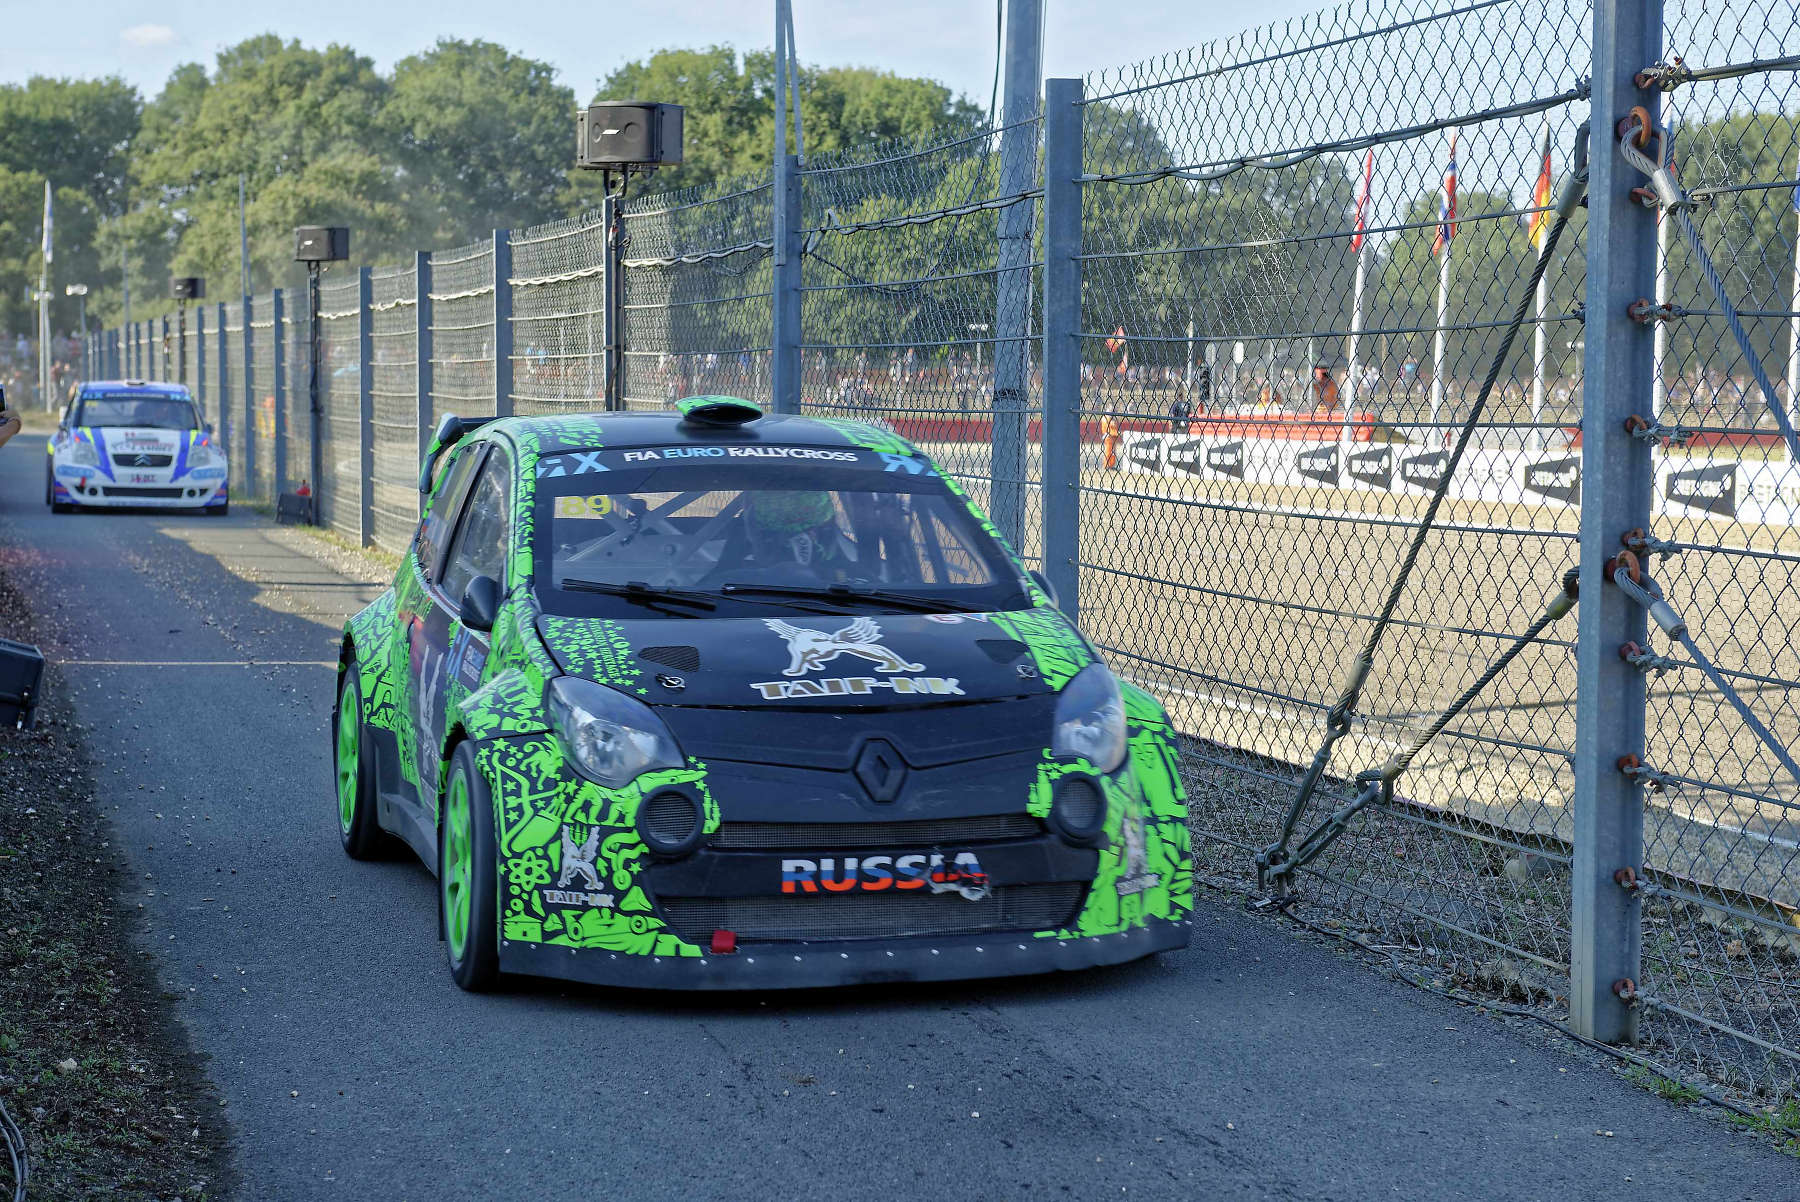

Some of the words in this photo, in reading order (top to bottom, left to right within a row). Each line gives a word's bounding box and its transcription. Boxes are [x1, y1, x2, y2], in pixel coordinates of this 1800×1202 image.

[624, 450, 661, 462] FIA
[663, 447, 725, 459] EURO
[727, 447, 859, 462] RALLYCROSS
[561, 495, 612, 515] 89
[750, 676, 966, 700] TAIF-NK
